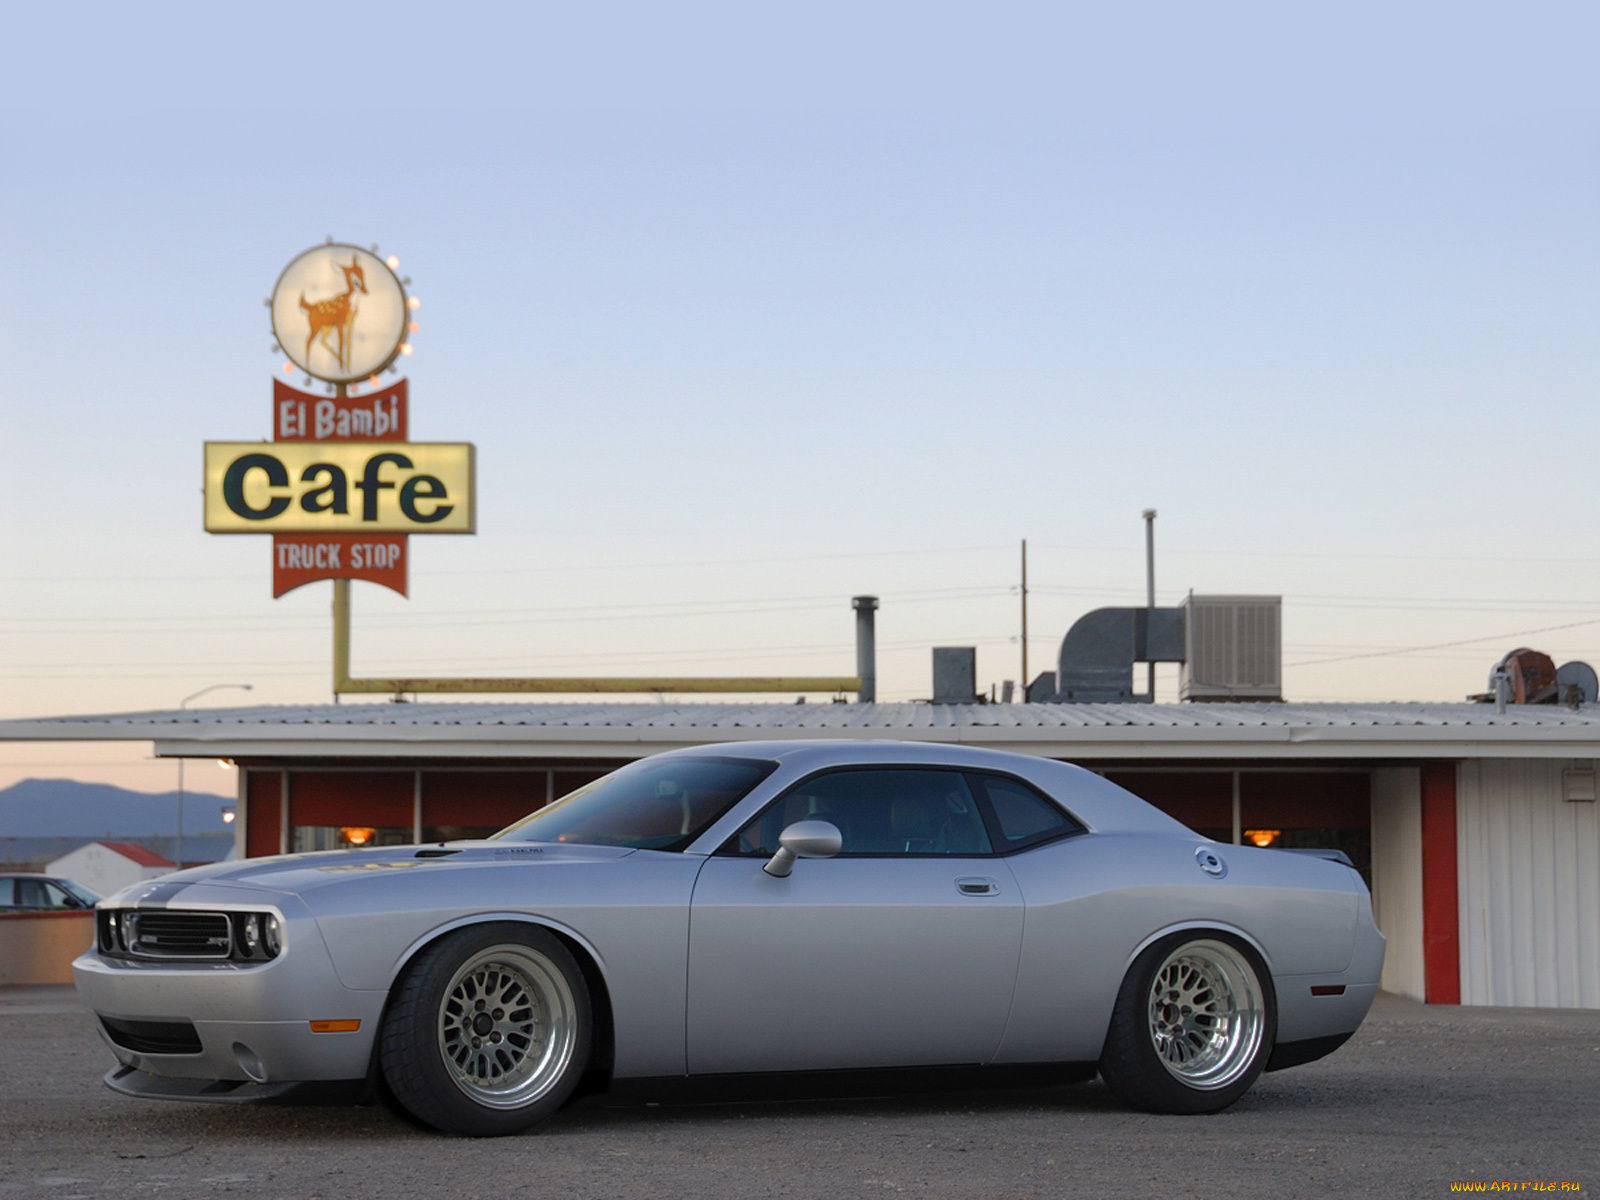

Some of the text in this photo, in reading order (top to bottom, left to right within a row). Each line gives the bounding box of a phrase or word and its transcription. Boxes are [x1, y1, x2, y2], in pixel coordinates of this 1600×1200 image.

[280, 395, 398, 439] El Bambi
[223, 453, 455, 523] Cafe
[277, 544, 400, 569] TRUCK STOP
